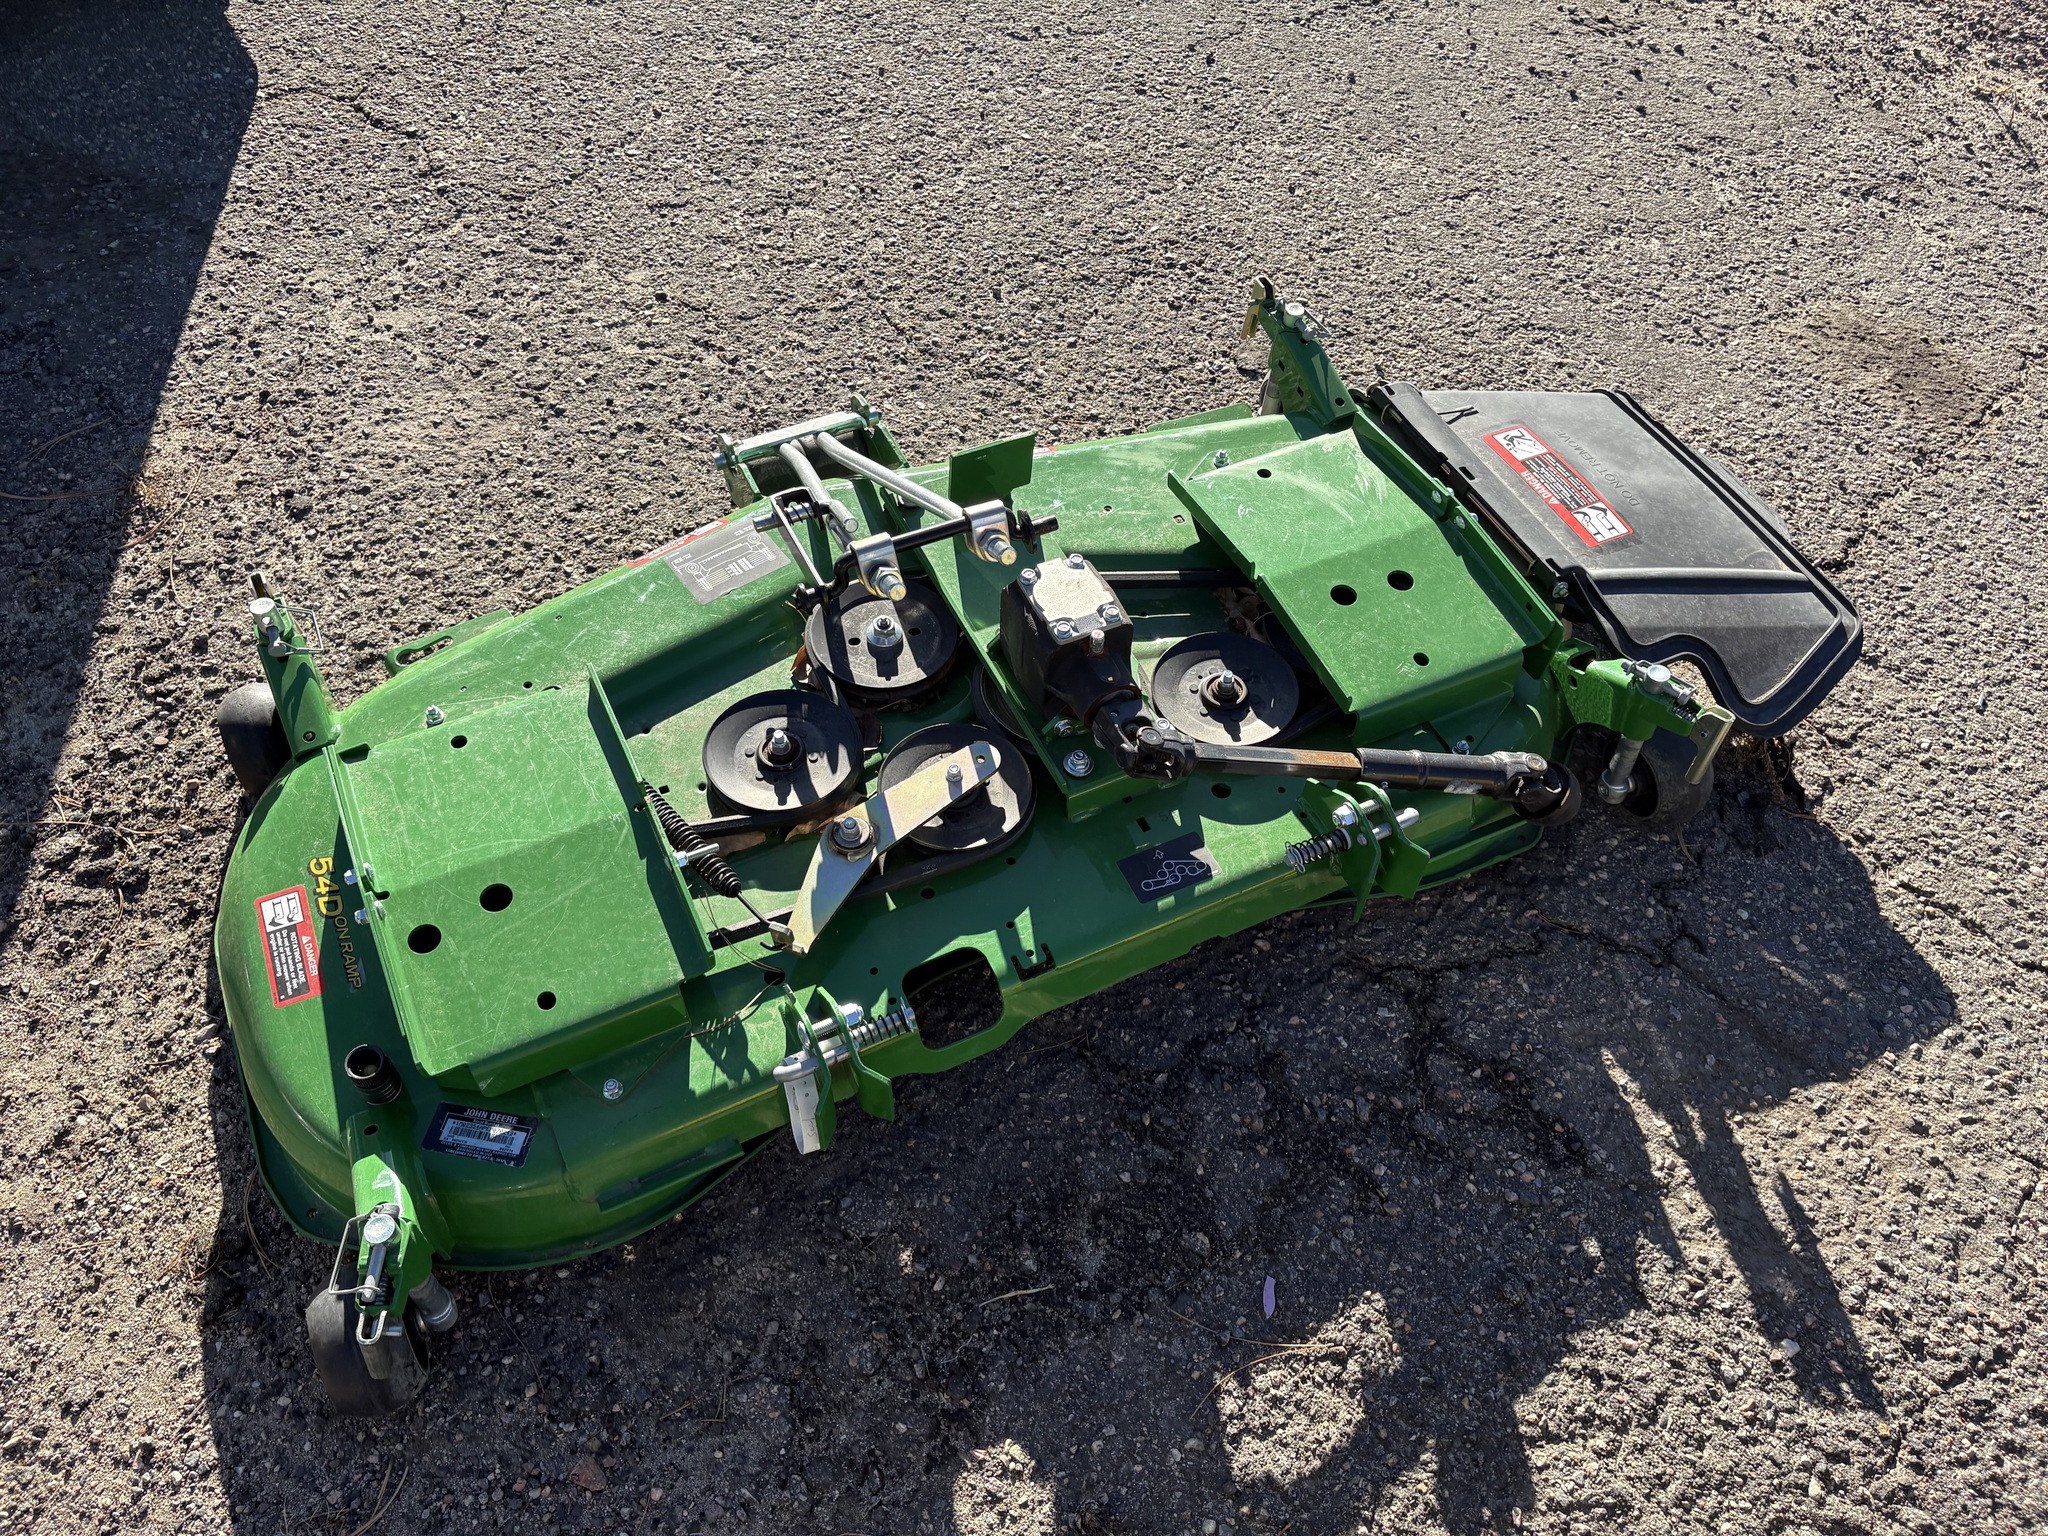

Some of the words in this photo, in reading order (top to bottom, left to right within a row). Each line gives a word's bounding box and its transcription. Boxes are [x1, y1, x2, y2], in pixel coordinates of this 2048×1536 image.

[1554, 430, 1601, 468] REMOVE
[1520, 471, 1552, 499] DANGER
[1600, 469, 1624, 490] NOT
[1621, 490, 1640, 507] DO
[308, 857, 344, 917] 54D
[335, 916, 350, 939] ON
[287, 956, 295, 972] hands
[290, 931, 301, 963] ROTATING
[296, 963, 306, 983] BLADE
[304, 943, 318, 977] DANGER
[341, 942, 362, 988] RAMP
[464, 1108, 488, 1119] JOHN
[490, 1112, 518, 1124] DEERE
